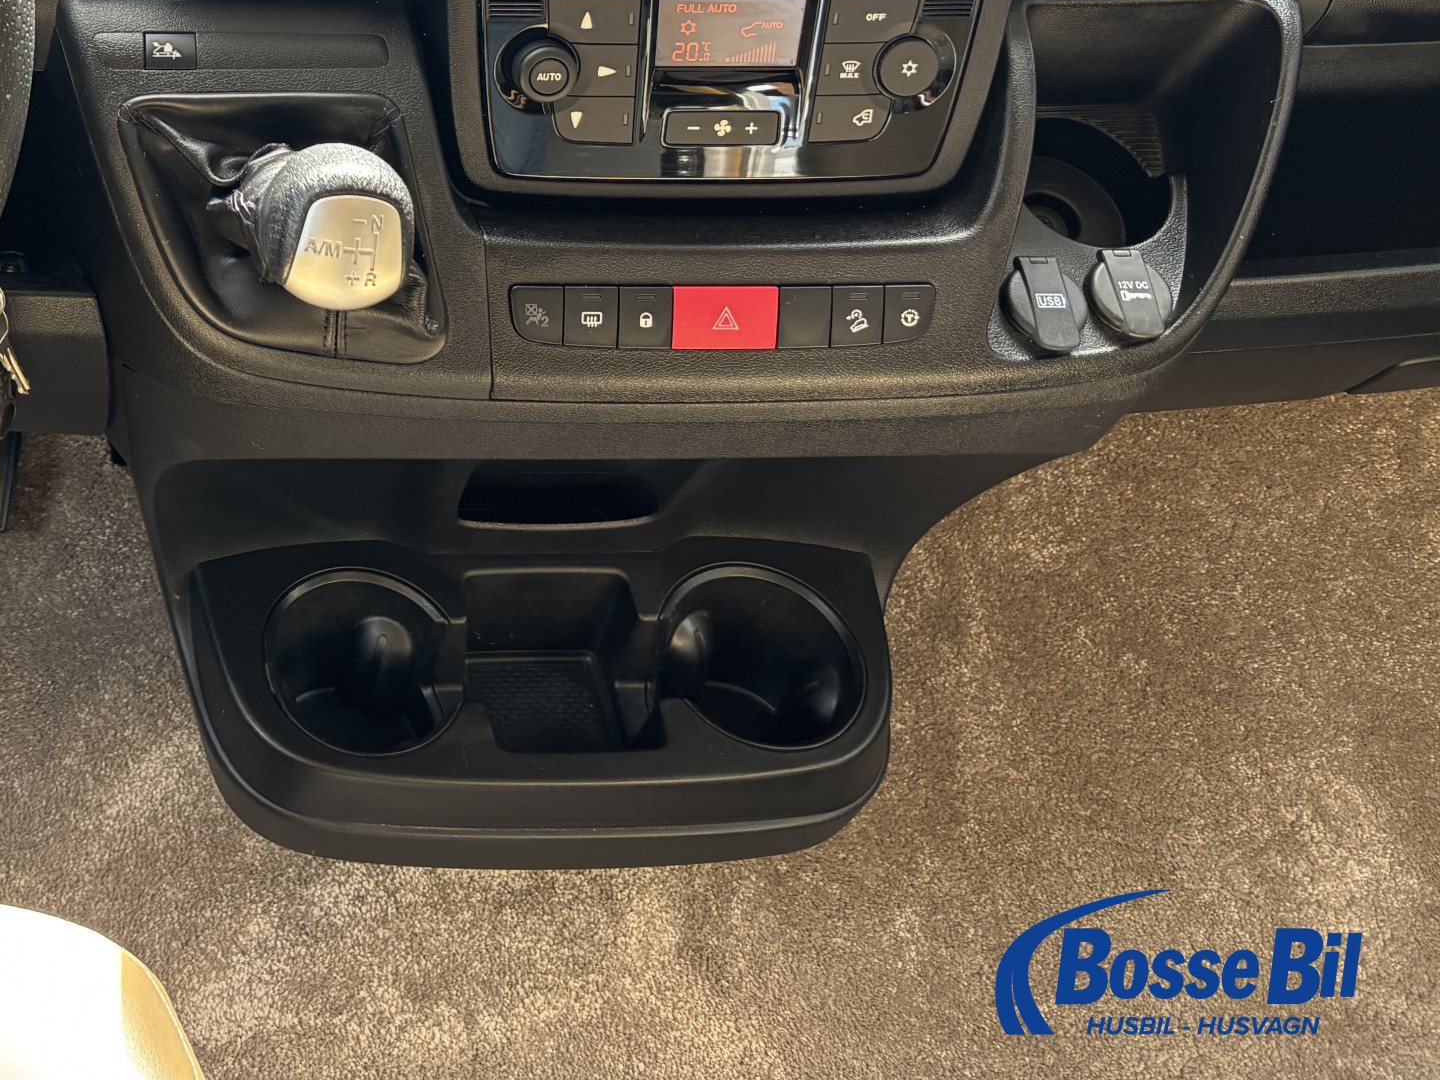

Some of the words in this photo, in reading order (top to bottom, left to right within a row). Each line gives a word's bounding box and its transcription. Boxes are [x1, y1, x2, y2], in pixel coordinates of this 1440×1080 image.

[676, 3, 704, 14] FULL
[707, 3, 738, 14] AUTO
[865, 13, 887, 22] OFF
[760, 21, 784, 30] AUTO
[536, 71, 562, 83] AUTO
[370, 214, 385, 232] N
[364, 272, 377, 287] R
[1117, 281, 1134, 290] 12V
[1135, 281, 1149, 290] DC
[1038, 295, 1063, 307] USB
